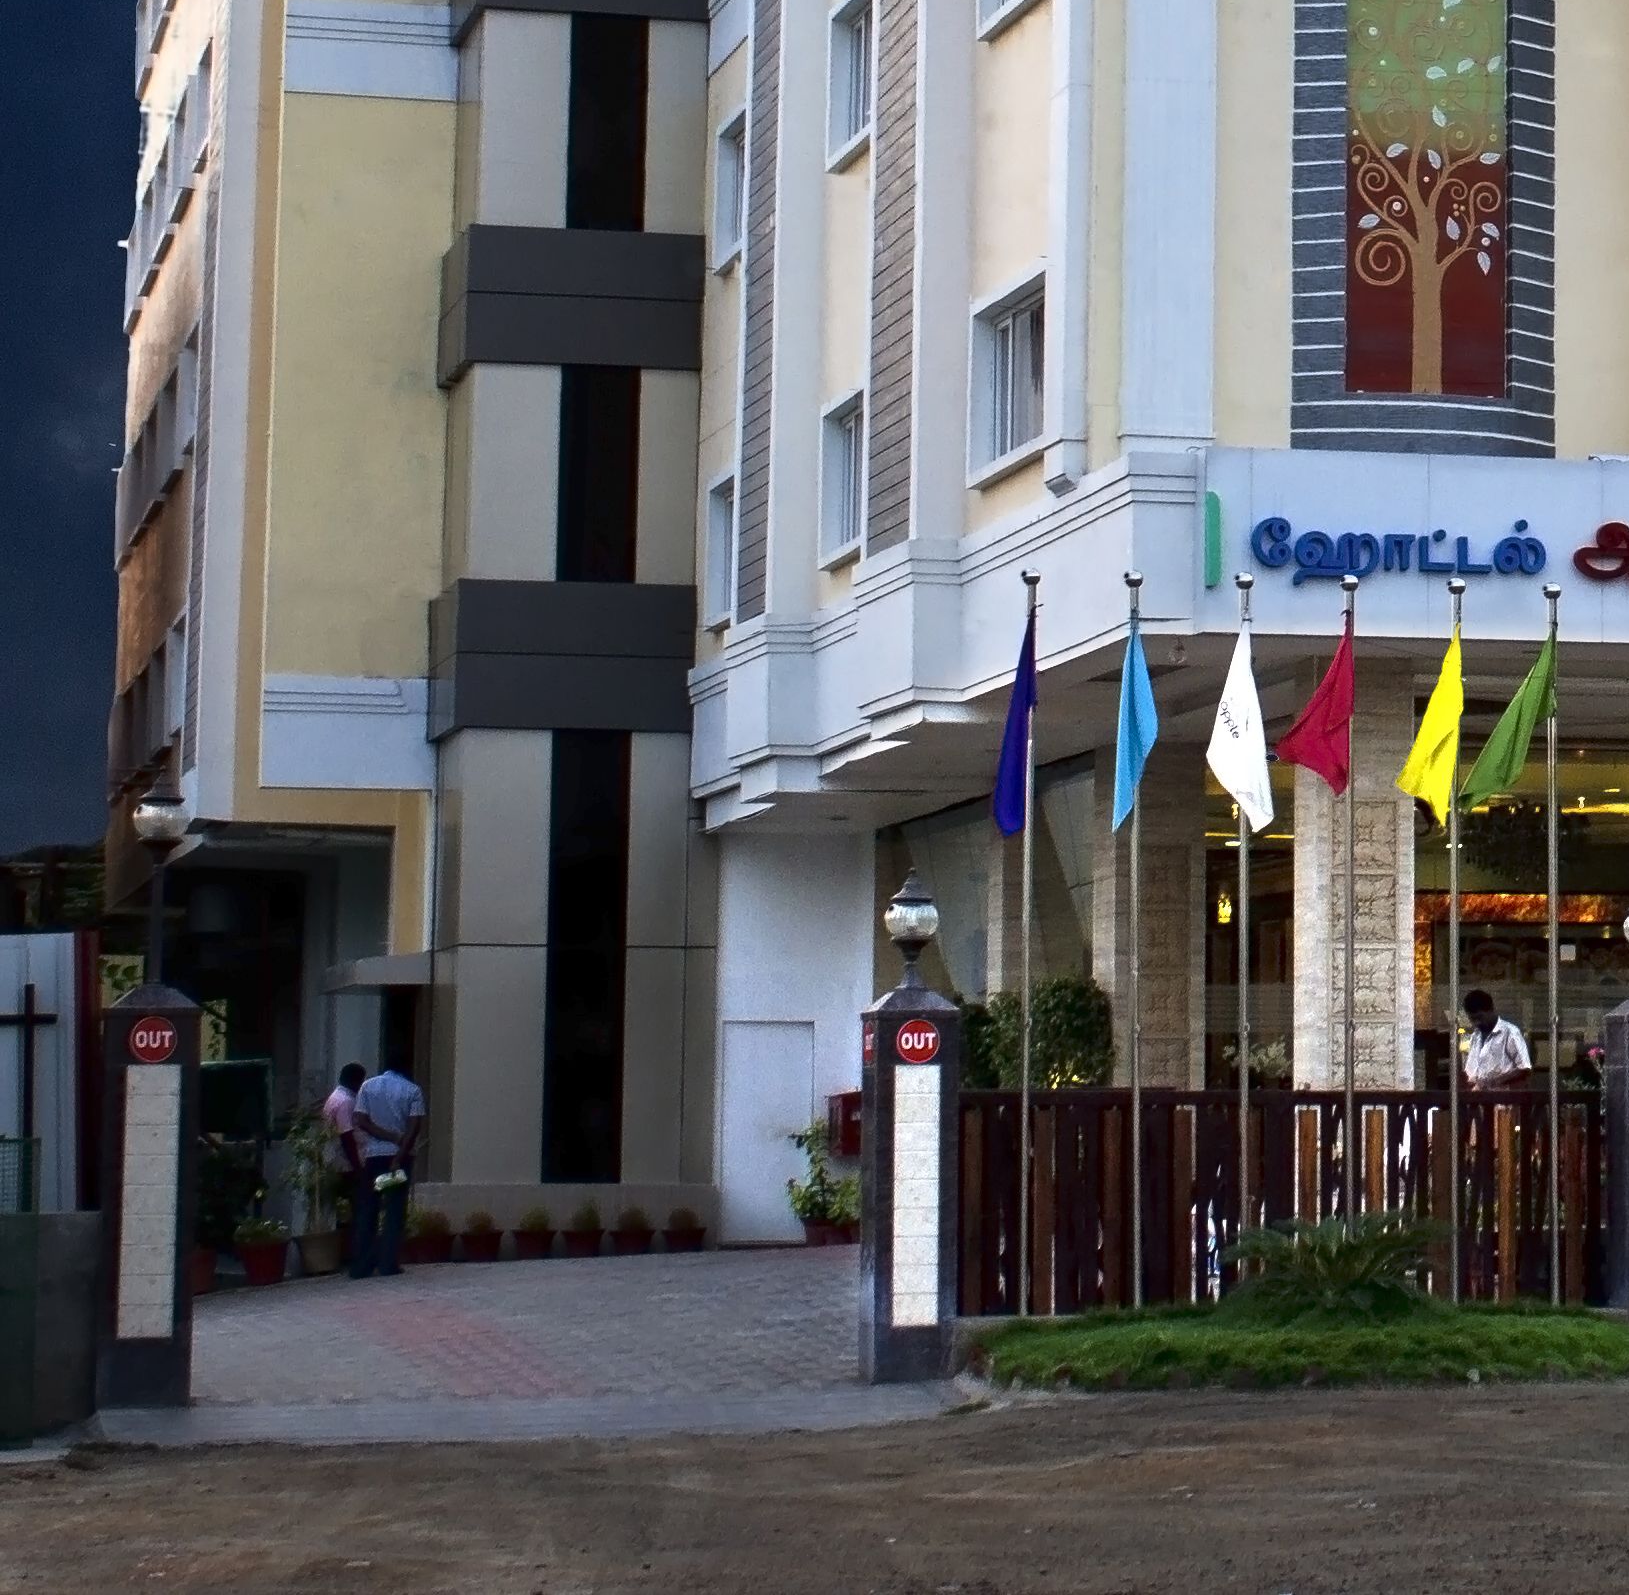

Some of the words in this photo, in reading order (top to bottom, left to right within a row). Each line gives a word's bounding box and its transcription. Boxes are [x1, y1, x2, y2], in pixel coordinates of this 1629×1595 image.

[1250, 516, 1547, 586] ஹோட்டல்
[135, 1030, 174, 1049] OUT
[901, 1032, 936, 1050] OUT
